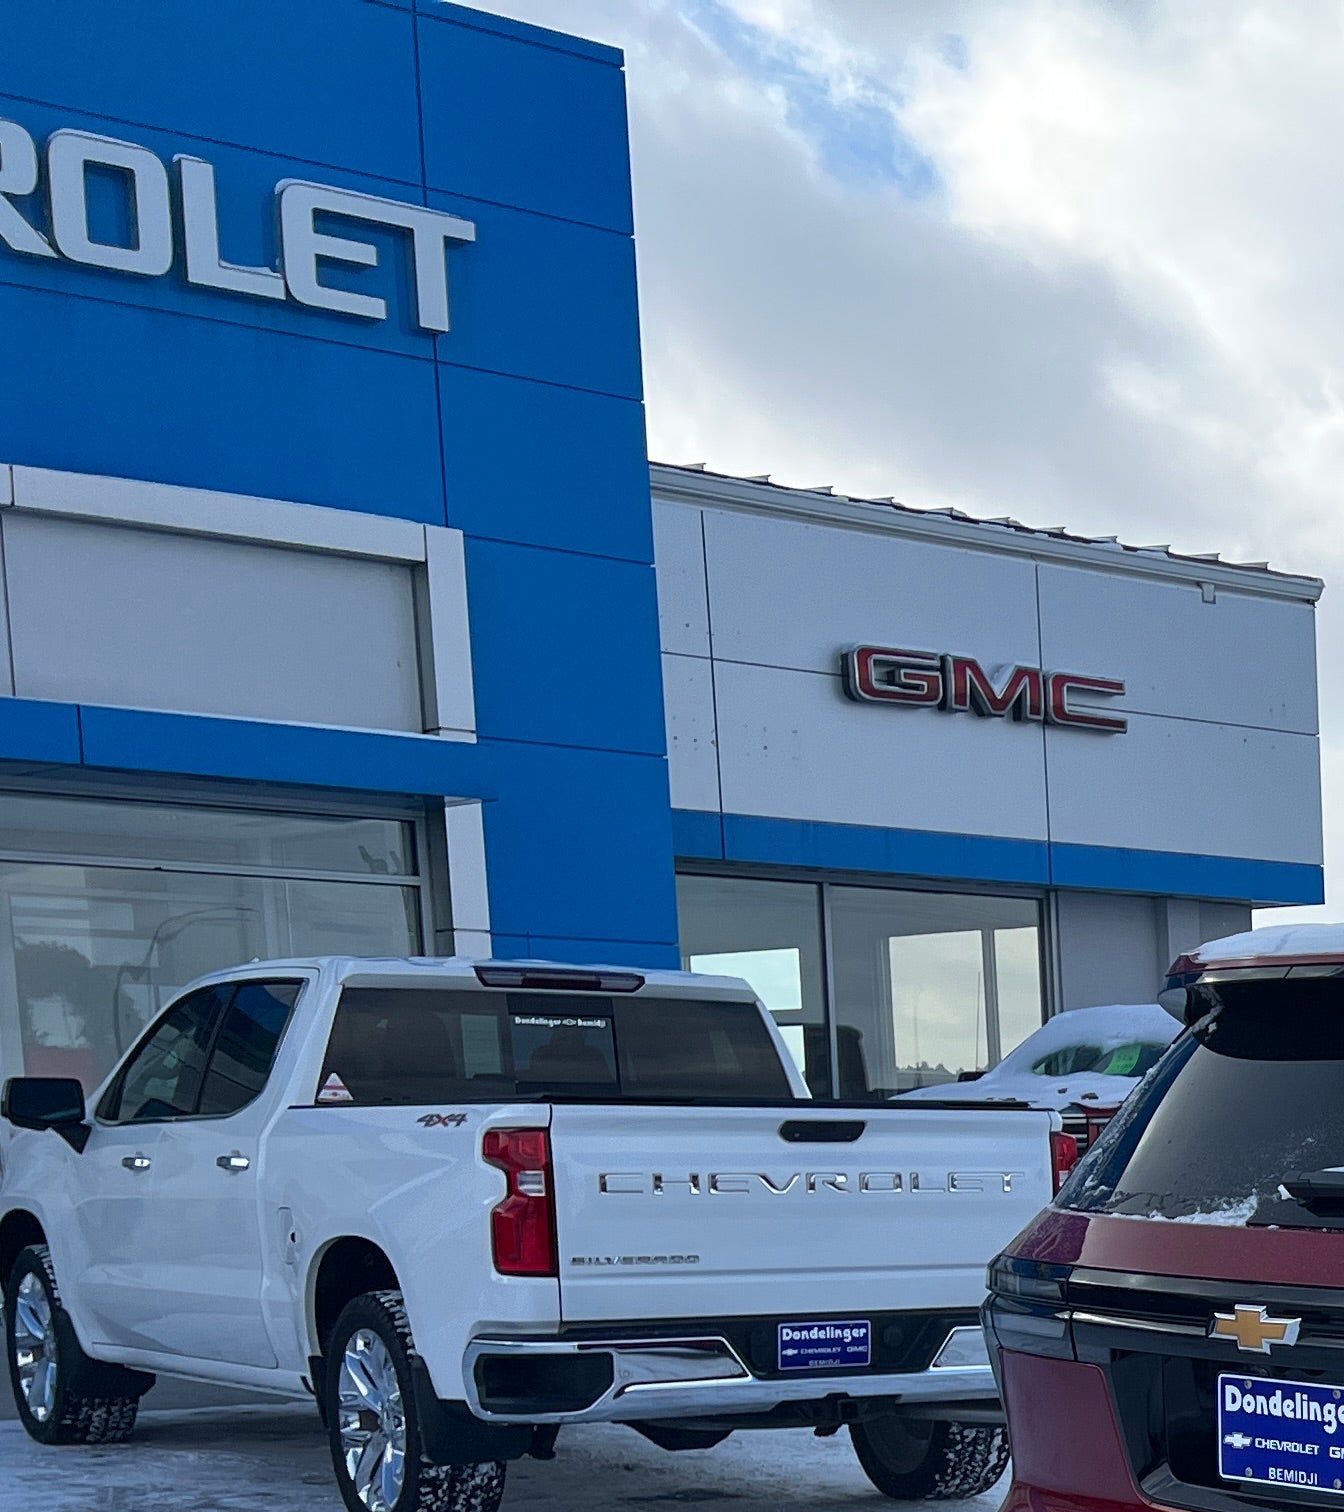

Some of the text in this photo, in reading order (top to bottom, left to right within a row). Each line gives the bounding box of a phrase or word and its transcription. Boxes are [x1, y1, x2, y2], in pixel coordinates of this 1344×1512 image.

[841, 643, 1128, 735] GMC
[598, 1171, 1026, 1196] CHEVROLET
[569, 1254, 700, 1266] SILVERADO
[782, 1326, 867, 1343] Dondelinger
[1254, 1437, 1320, 1456] CHEVROLET
[1268, 1467, 1318, 1486] BEMIDJI
